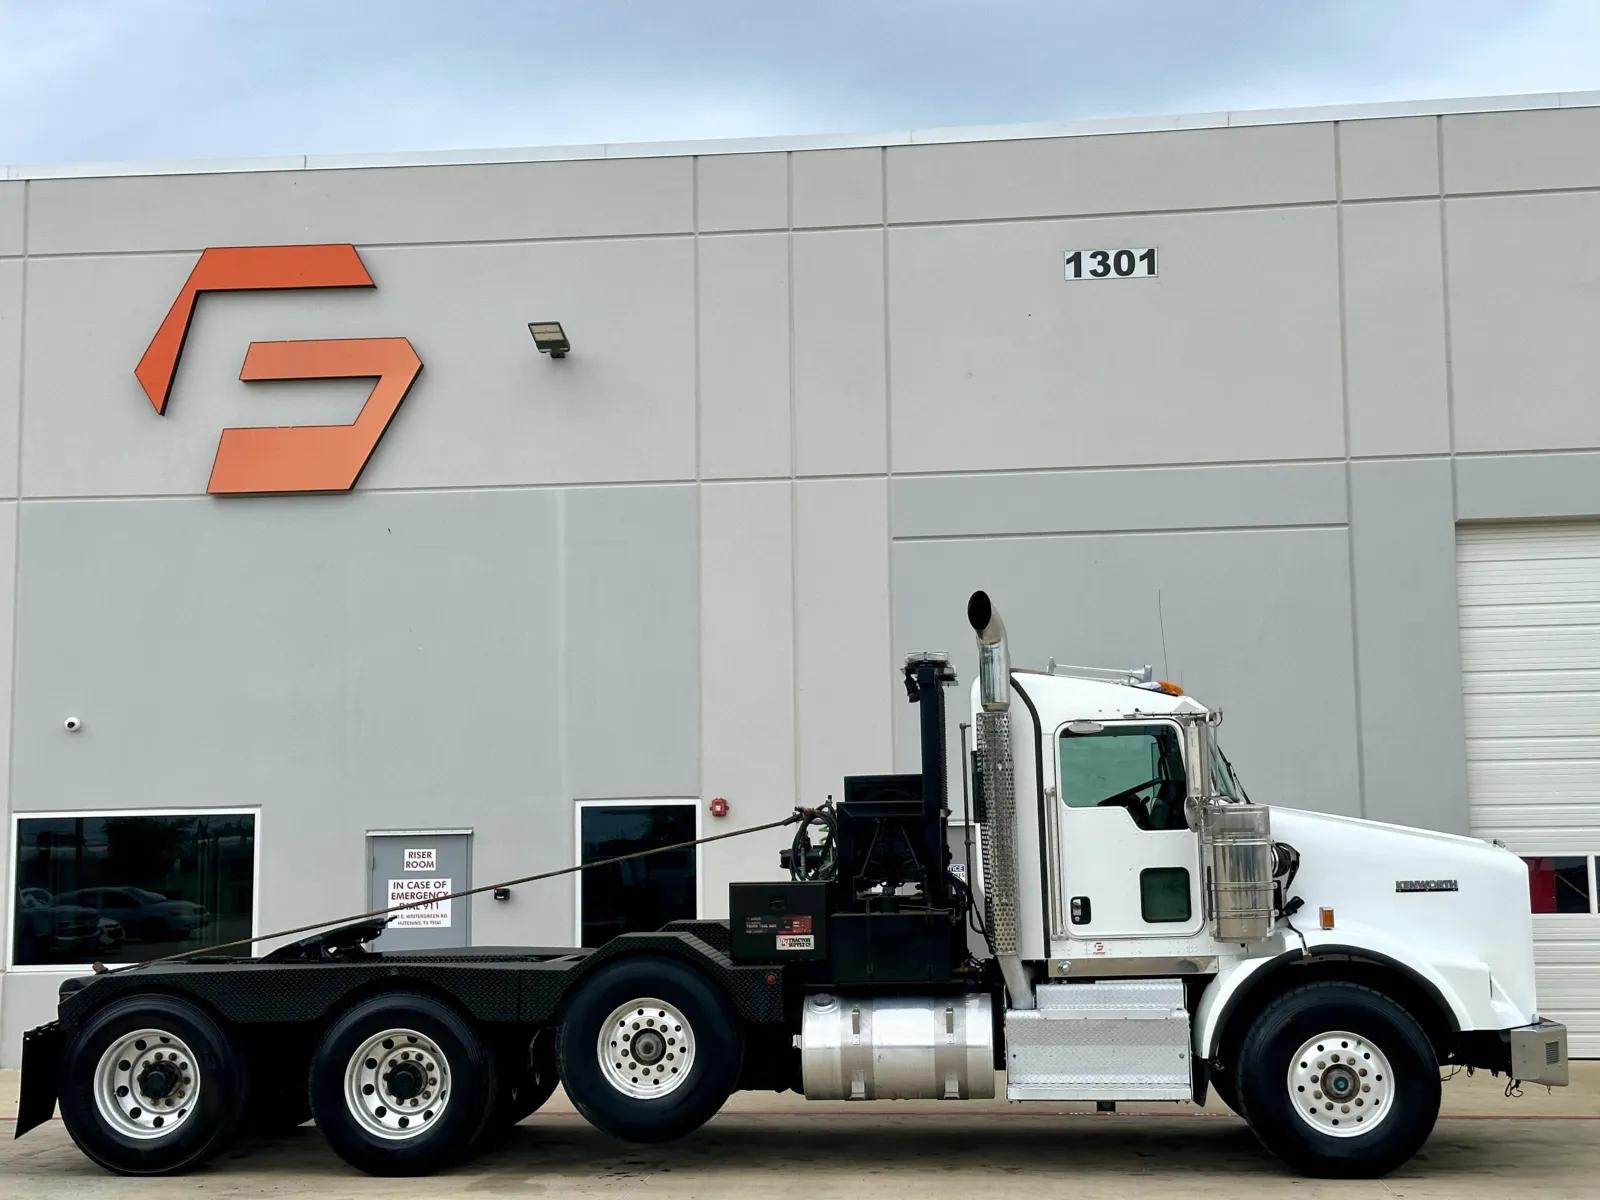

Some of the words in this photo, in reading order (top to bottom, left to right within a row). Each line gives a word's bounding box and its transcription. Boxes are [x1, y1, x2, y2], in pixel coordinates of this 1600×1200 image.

[1065, 248, 1156, 278] 1301
[406, 860, 434, 868] ROOM
[393, 882, 404, 890] IN
[407, 881, 430, 890] CASE
[434, 880, 446, 888] OF
[1396, 880, 1458, 889] KENWORTH
[391, 891, 449, 900] EMERGENCY
